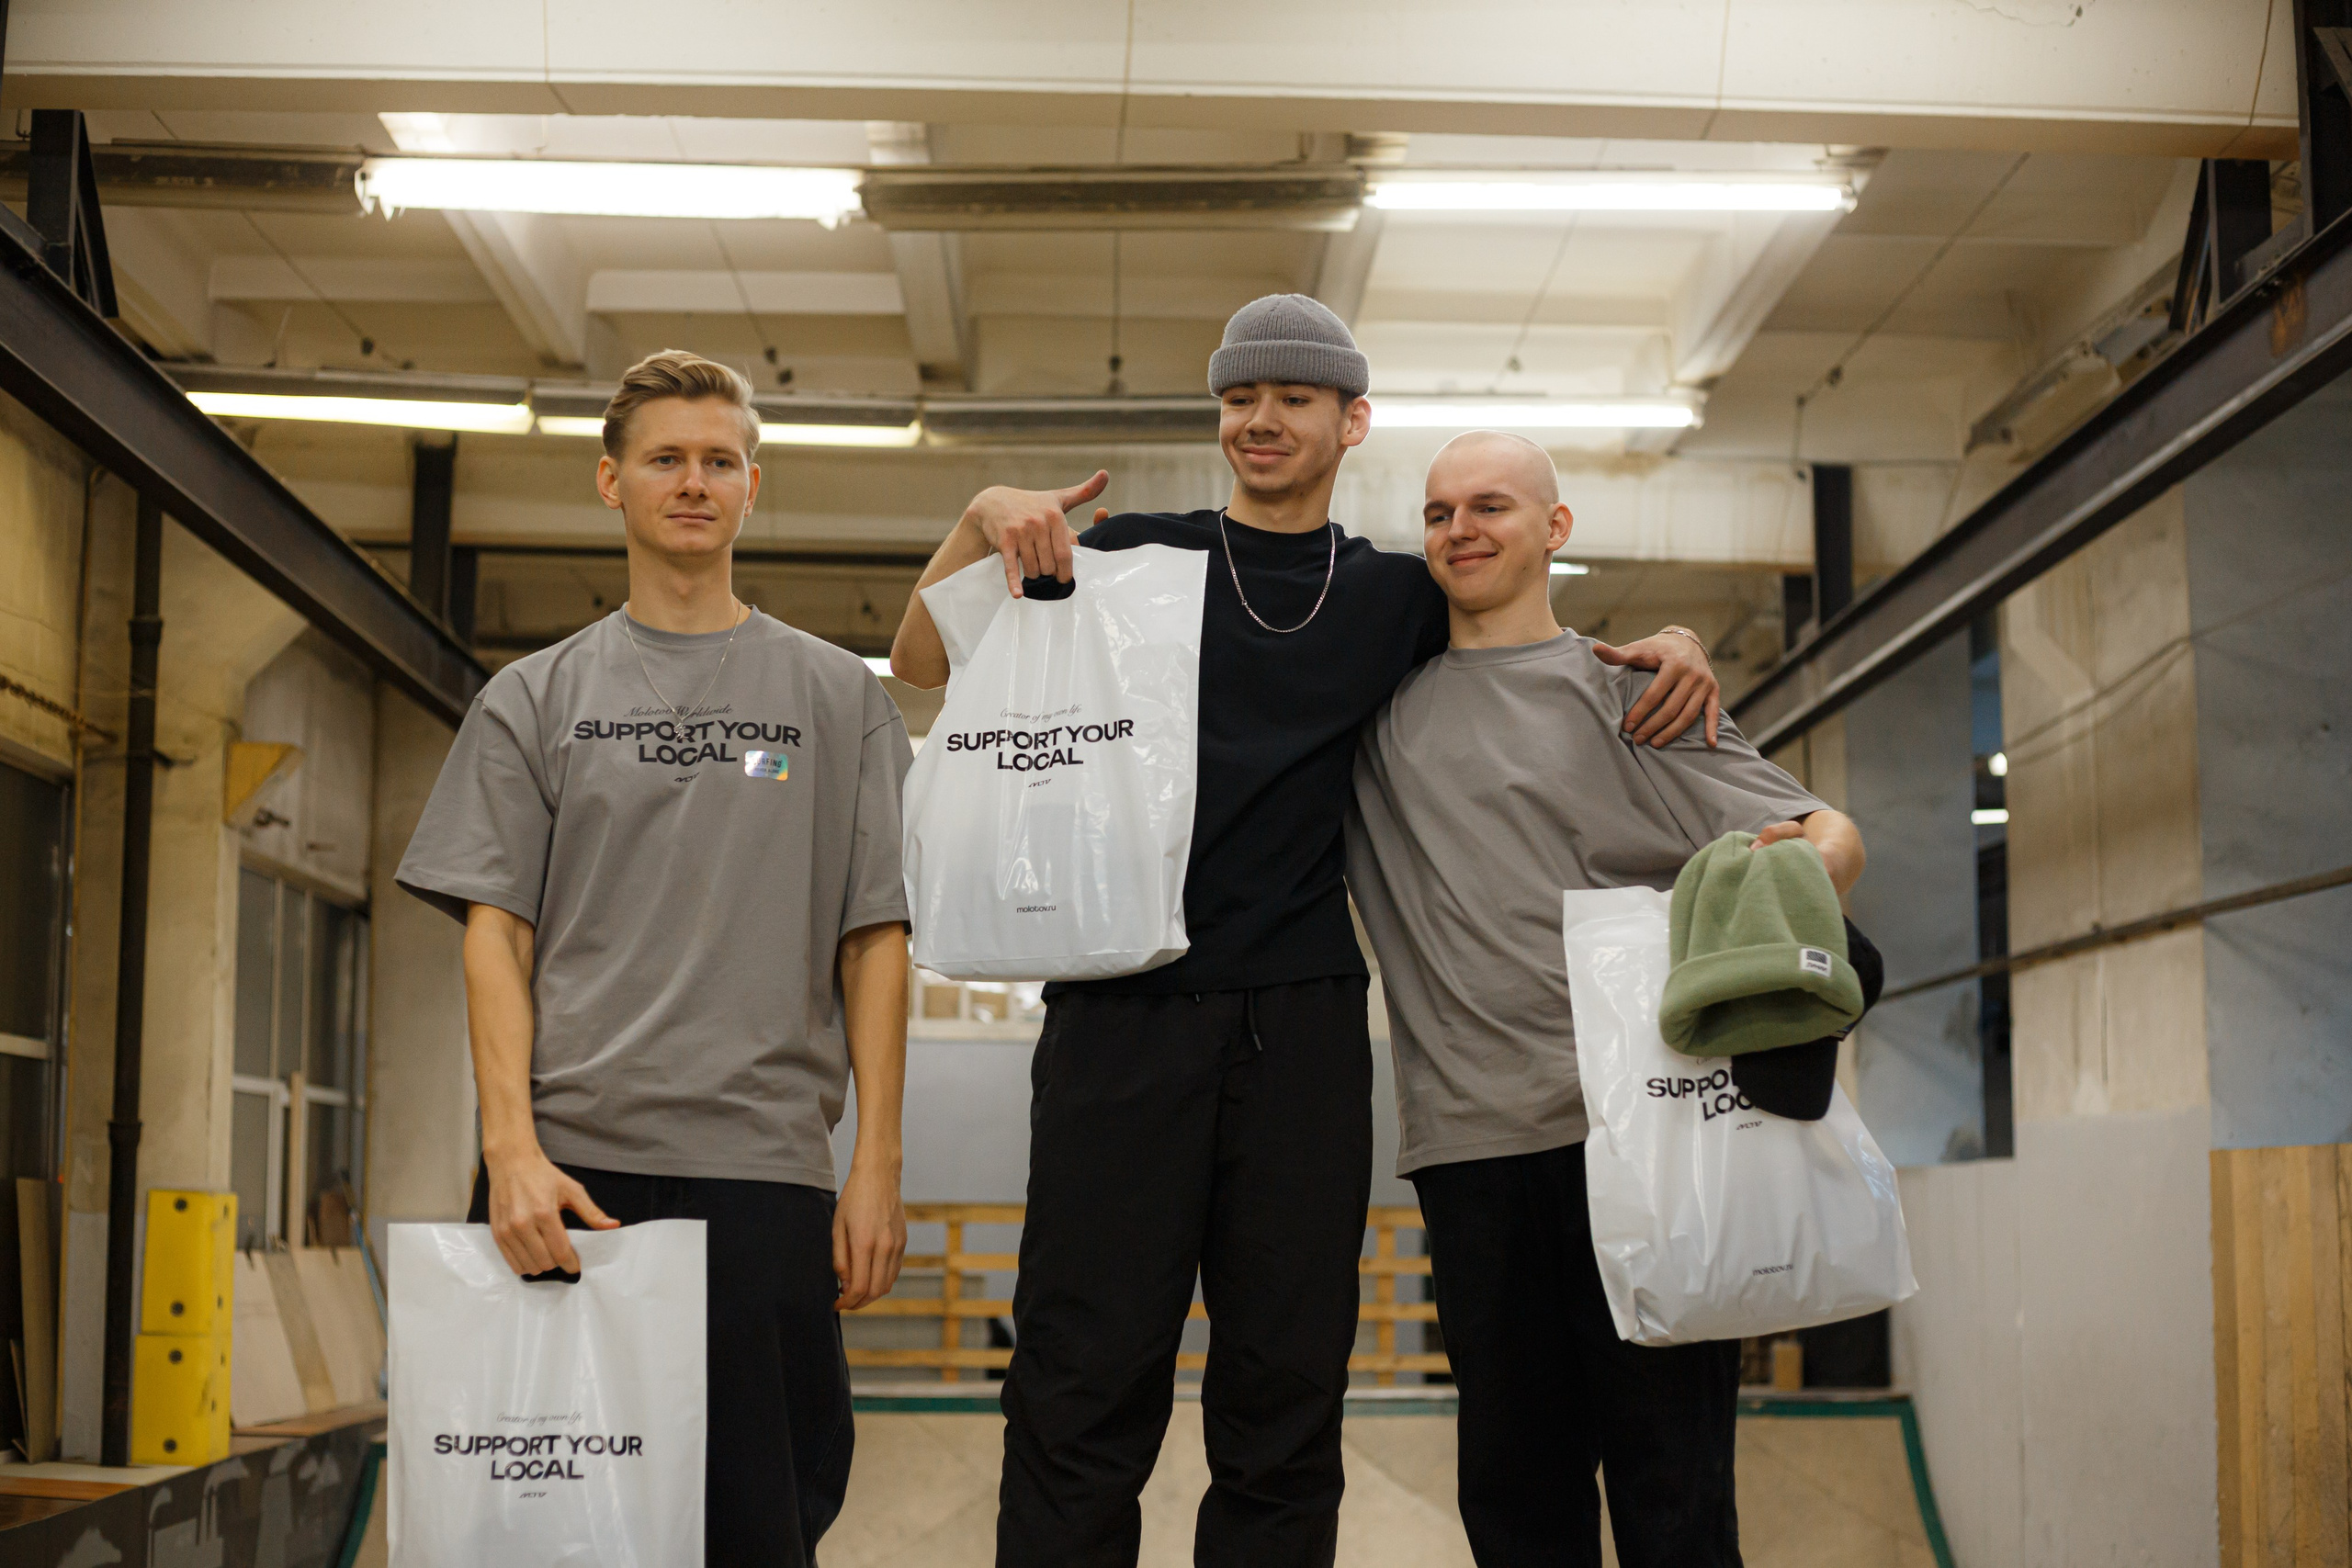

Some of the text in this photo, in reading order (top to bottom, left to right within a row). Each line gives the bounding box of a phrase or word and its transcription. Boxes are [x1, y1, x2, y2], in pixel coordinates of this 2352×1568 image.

[1001, 708, 1030, 719] Creator
[1030, 712, 1044, 724] of
[1068, 704, 1082, 716] life
[573, 720, 801, 748] SUPPORT YOUR
[946, 719, 1134, 751] SUPPORT YOUR
[639, 742, 737, 766] LOCAL
[997, 748, 1084, 772] LOCAL
[1016, 905, 1057, 913] molotov.ru
[1645, 1069, 1731, 1099] SUPPO
[1702, 1091, 1755, 1122] LOC
[434, 1434, 642, 1457] SUPPORT YOUR
[491, 1460, 584, 1481] LOCAL
